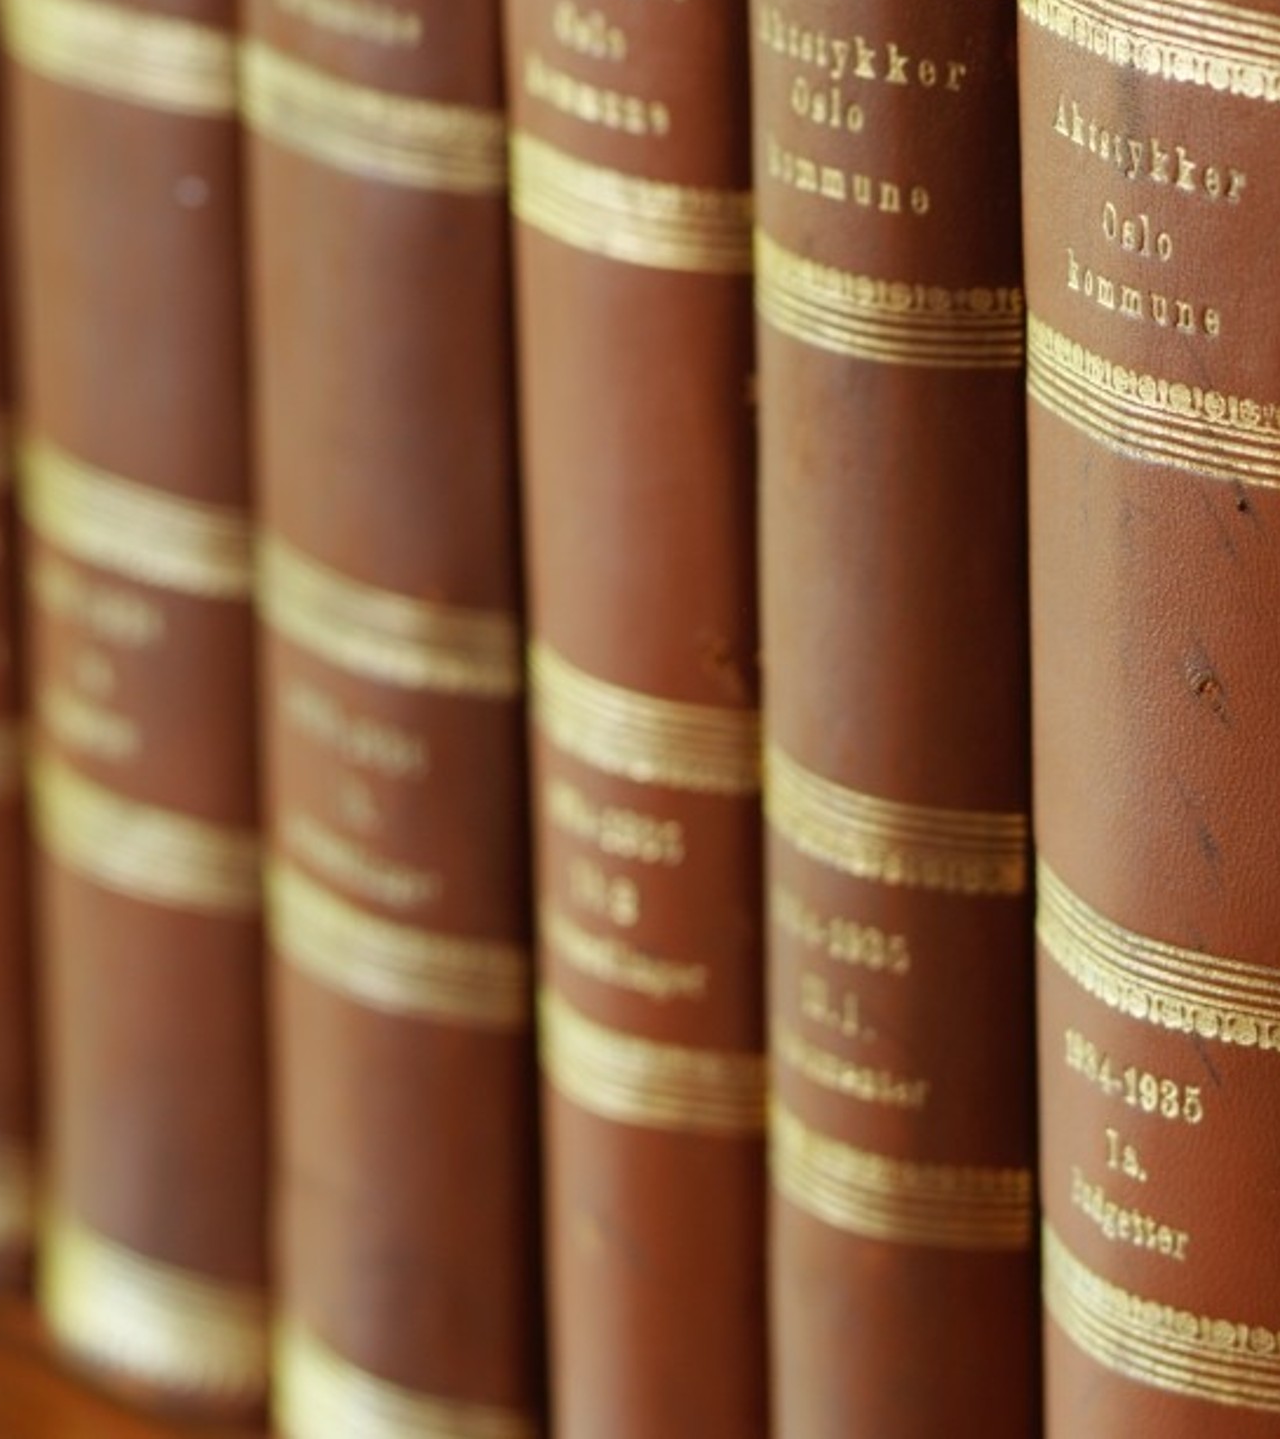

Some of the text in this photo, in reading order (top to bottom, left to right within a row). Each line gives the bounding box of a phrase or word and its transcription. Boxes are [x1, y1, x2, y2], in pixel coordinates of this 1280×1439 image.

[791, 75, 864, 133] Oslo
[1054, 94, 1246, 204] Aktstykker
[1102, 200, 1173, 262] Oslo
[1067, 248, 1220, 336] kommune
